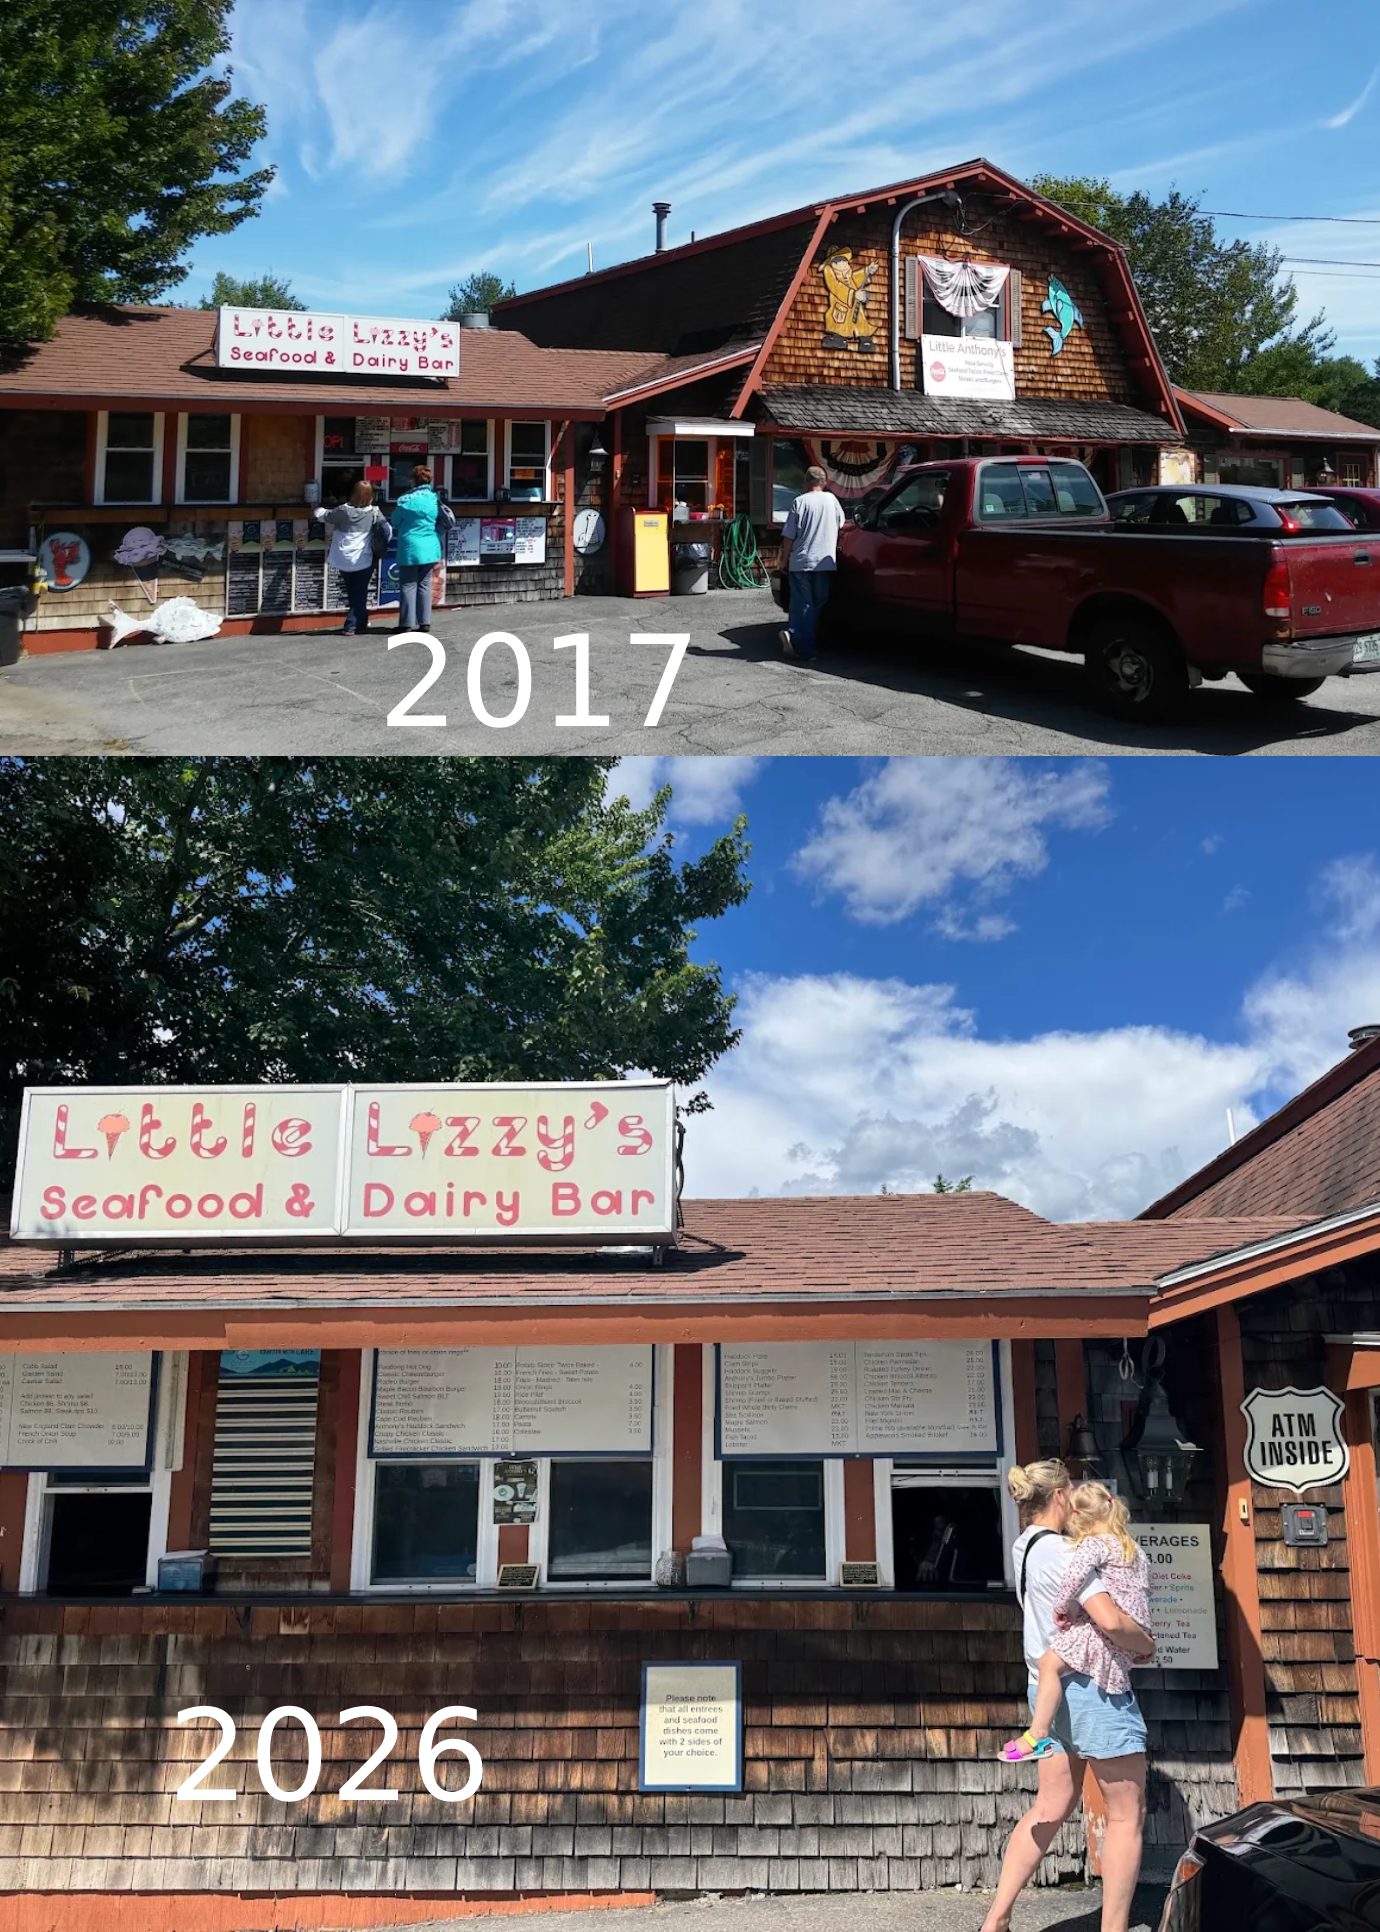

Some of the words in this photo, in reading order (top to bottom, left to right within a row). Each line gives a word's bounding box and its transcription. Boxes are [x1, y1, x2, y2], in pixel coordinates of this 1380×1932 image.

[234, 314, 335, 342] Little
[353, 321, 454, 352] Lizzy's
[929, 340, 955, 353] Little
[957, 344, 1007, 358] Anthony's
[231, 347, 317, 365] Seafood
[325, 351, 336, 365] &
[353, 353, 408, 371] Dairy
[418, 356, 454, 370] Bar
[54, 1102, 312, 1160] Little
[367, 1101, 653, 1172] Lizzy's
[40, 1183, 263, 1220] Seafood
[285, 1183, 316, 1218] &
[364, 1183, 520, 1227] Dairy
[551, 1181, 655, 1217] Bar
[1272, 1413, 1316, 1437] ATM
[1260, 1441, 1334, 1466] INSIDE
[1147, 1553, 1173, 1564] 3.00
[1152, 1572, 1169, 1580] Diet
[1170, 1572, 1192, 1580] Coke
[1169, 1583, 1195, 1593] Sprite
[1150, 1595, 1178, 1603] werade
[1164, 1606, 1208, 1615] Lemonade
[1150, 1620, 1171, 1629] berry
[1176, 1619, 1191, 1627] Tea
[1182, 1631, 1197, 1639] Tea
[1165, 1645, 1191, 1654] Water
[665, 1694, 695, 1702] Please
[659, 1704, 676, 1713] that
[677, 1704, 688, 1713] all
[690, 1705, 723, 1713] entrees
[663, 1715, 680, 1724] and
[682, 1715, 718, 1724] seafood
[663, 1727, 692, 1735] dishes
[663, 1750, 684, 1758] your
[685, 1748, 718, 1757] choice.
